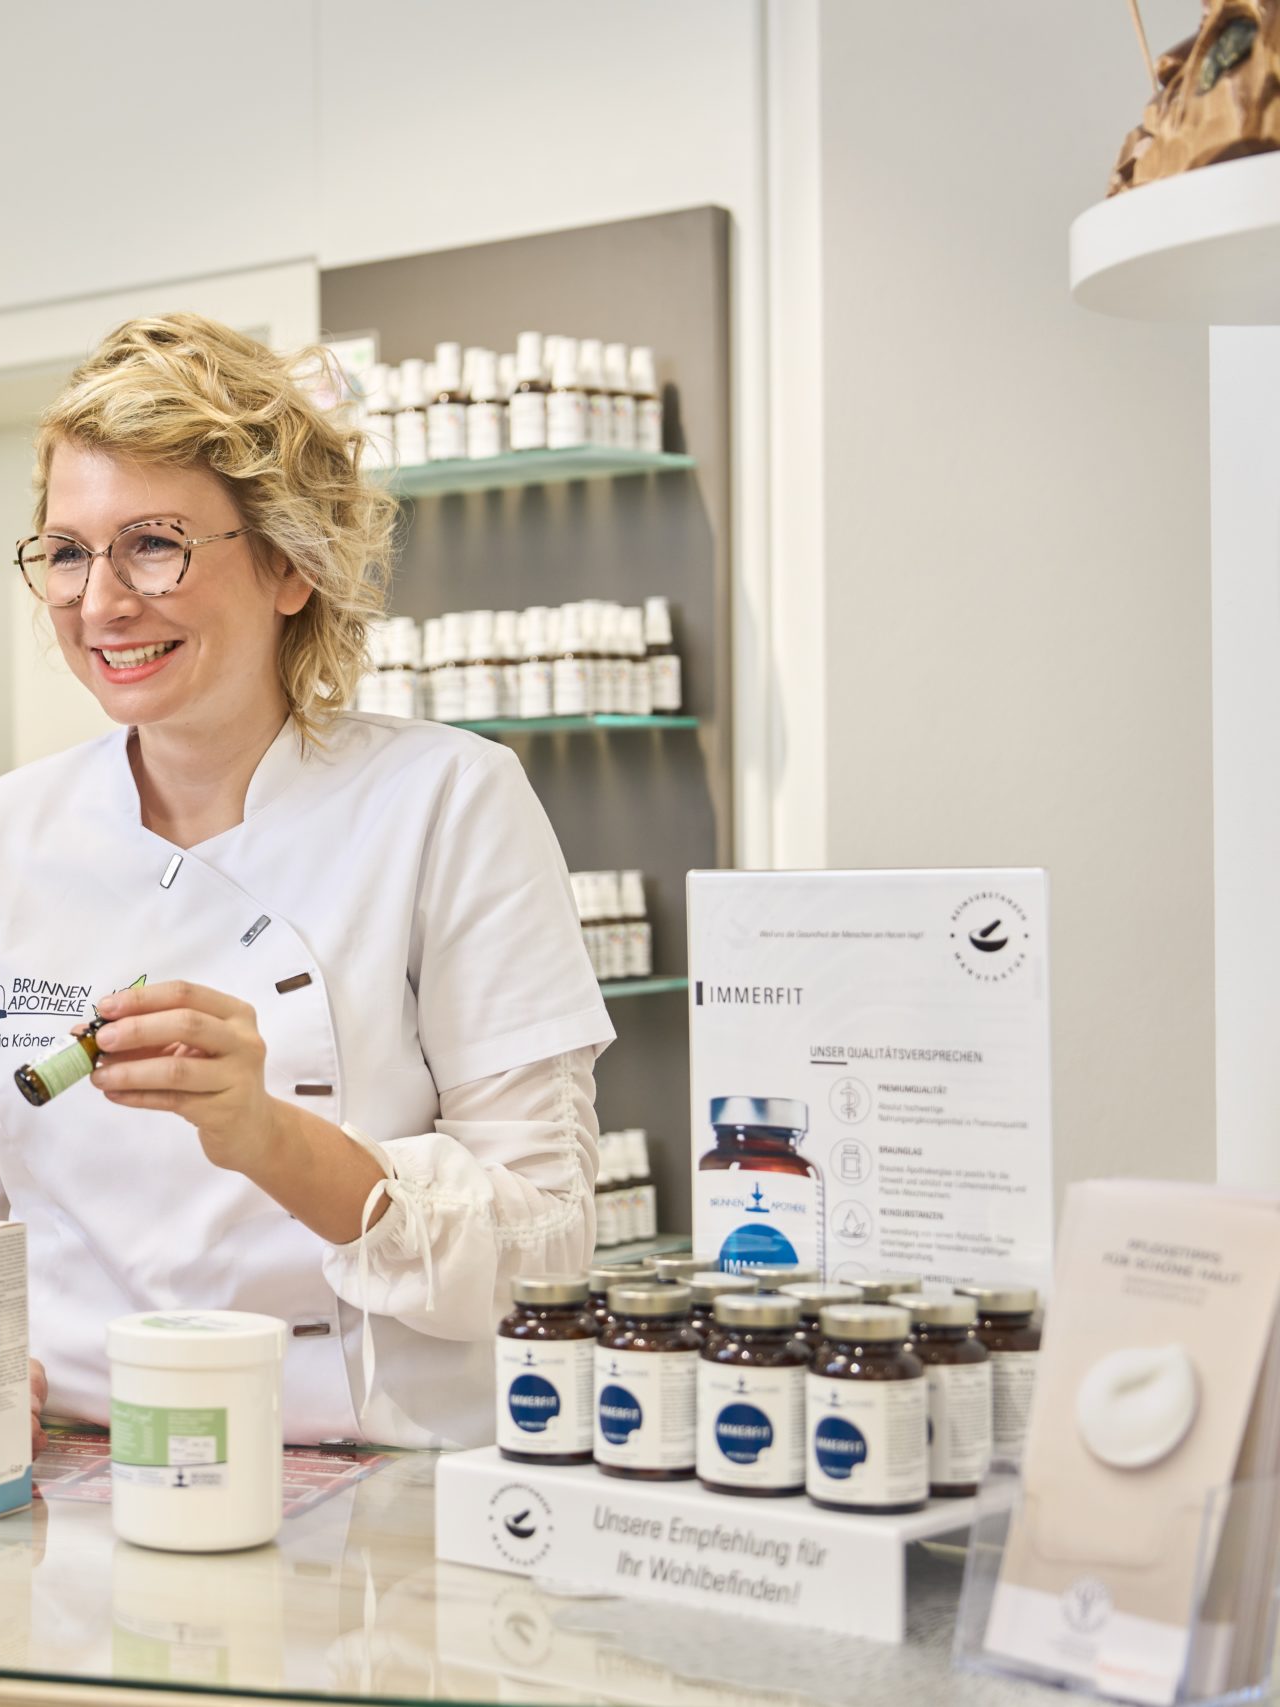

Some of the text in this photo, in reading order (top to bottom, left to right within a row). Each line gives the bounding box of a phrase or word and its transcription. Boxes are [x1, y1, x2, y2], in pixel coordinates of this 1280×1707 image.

[12, 978, 92, 998] BRUNNEN
[710, 986, 804, 1005] IMMERFIT
[8, 996, 86, 1012] APOTHEKE
[12, 1033, 56, 1047] Kröner
[810, 1045, 845, 1057] UNSER
[592, 1504, 828, 1567] Unsere Empfehlung für
[616, 1550, 802, 1606] Ihr Wohlbefinden!
